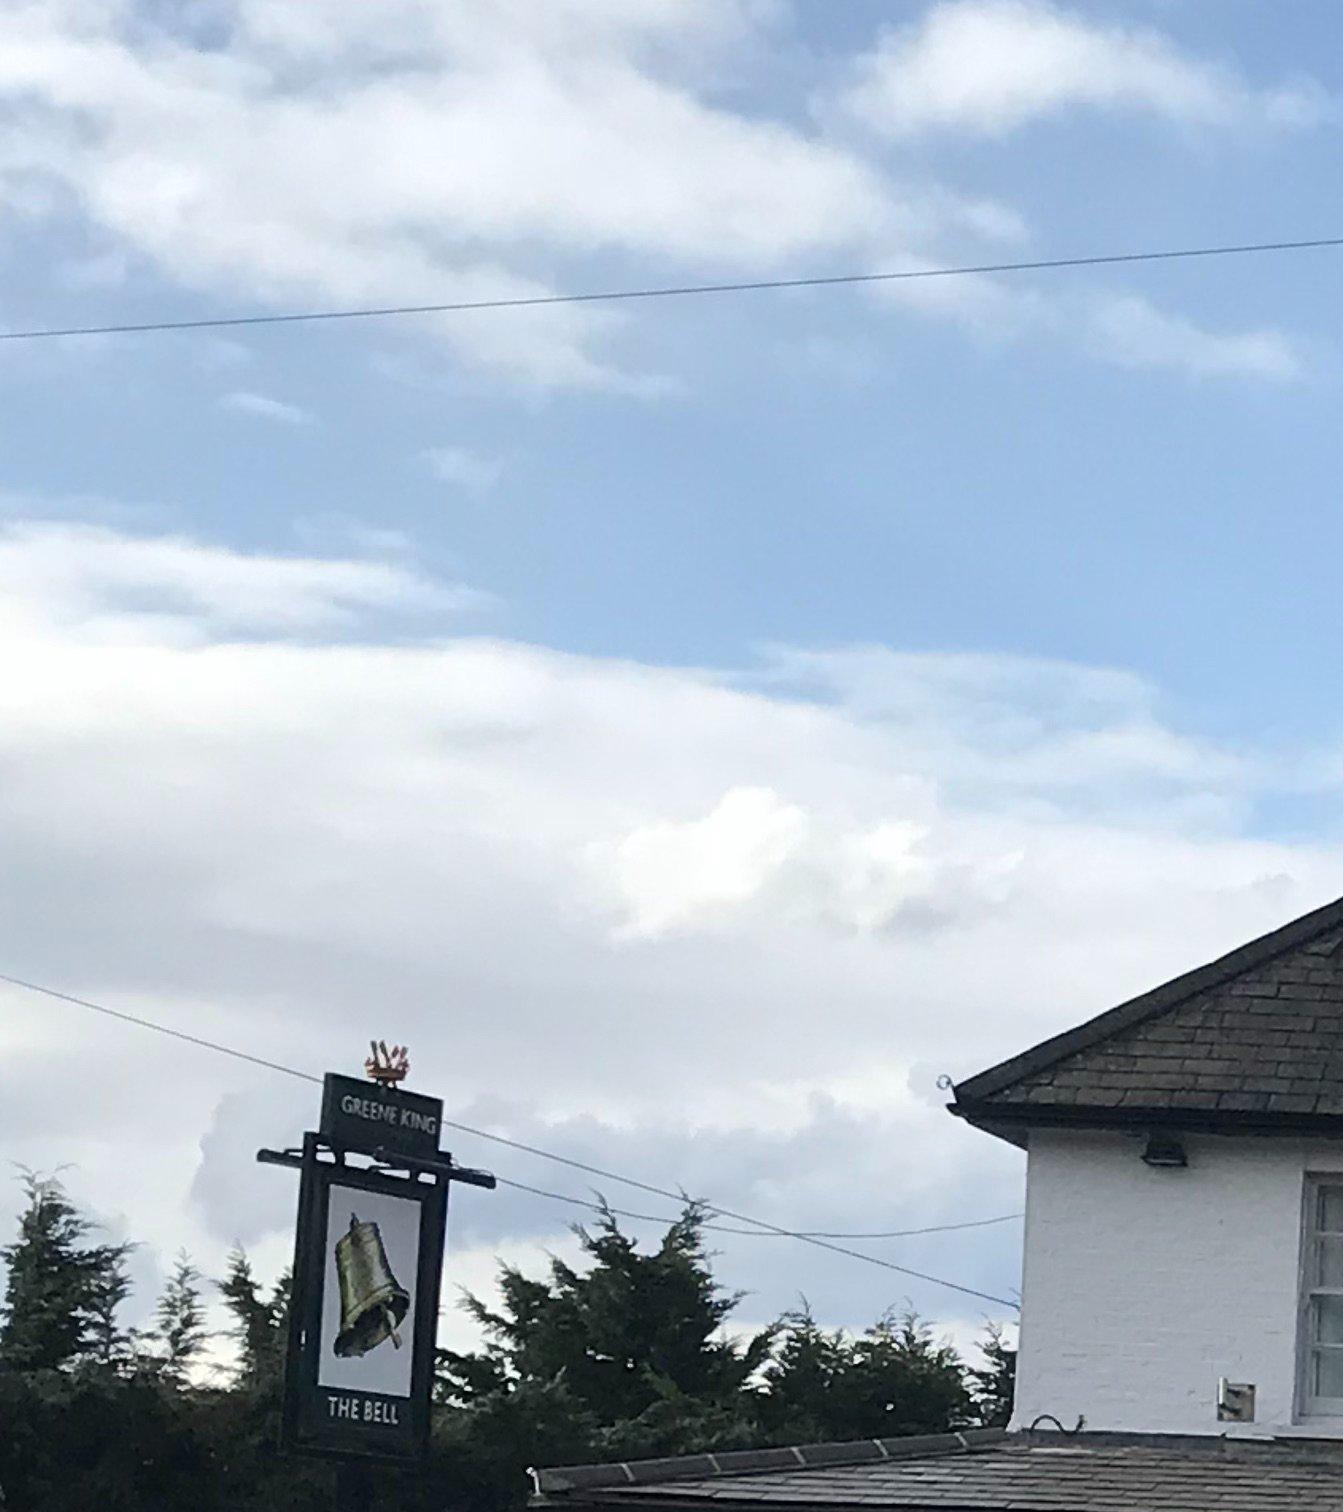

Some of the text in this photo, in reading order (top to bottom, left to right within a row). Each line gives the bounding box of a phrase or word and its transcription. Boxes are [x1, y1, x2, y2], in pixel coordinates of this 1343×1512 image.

[341, 1094, 437, 1136] GREENE KING
[328, 1396, 400, 1426] THE BELL
